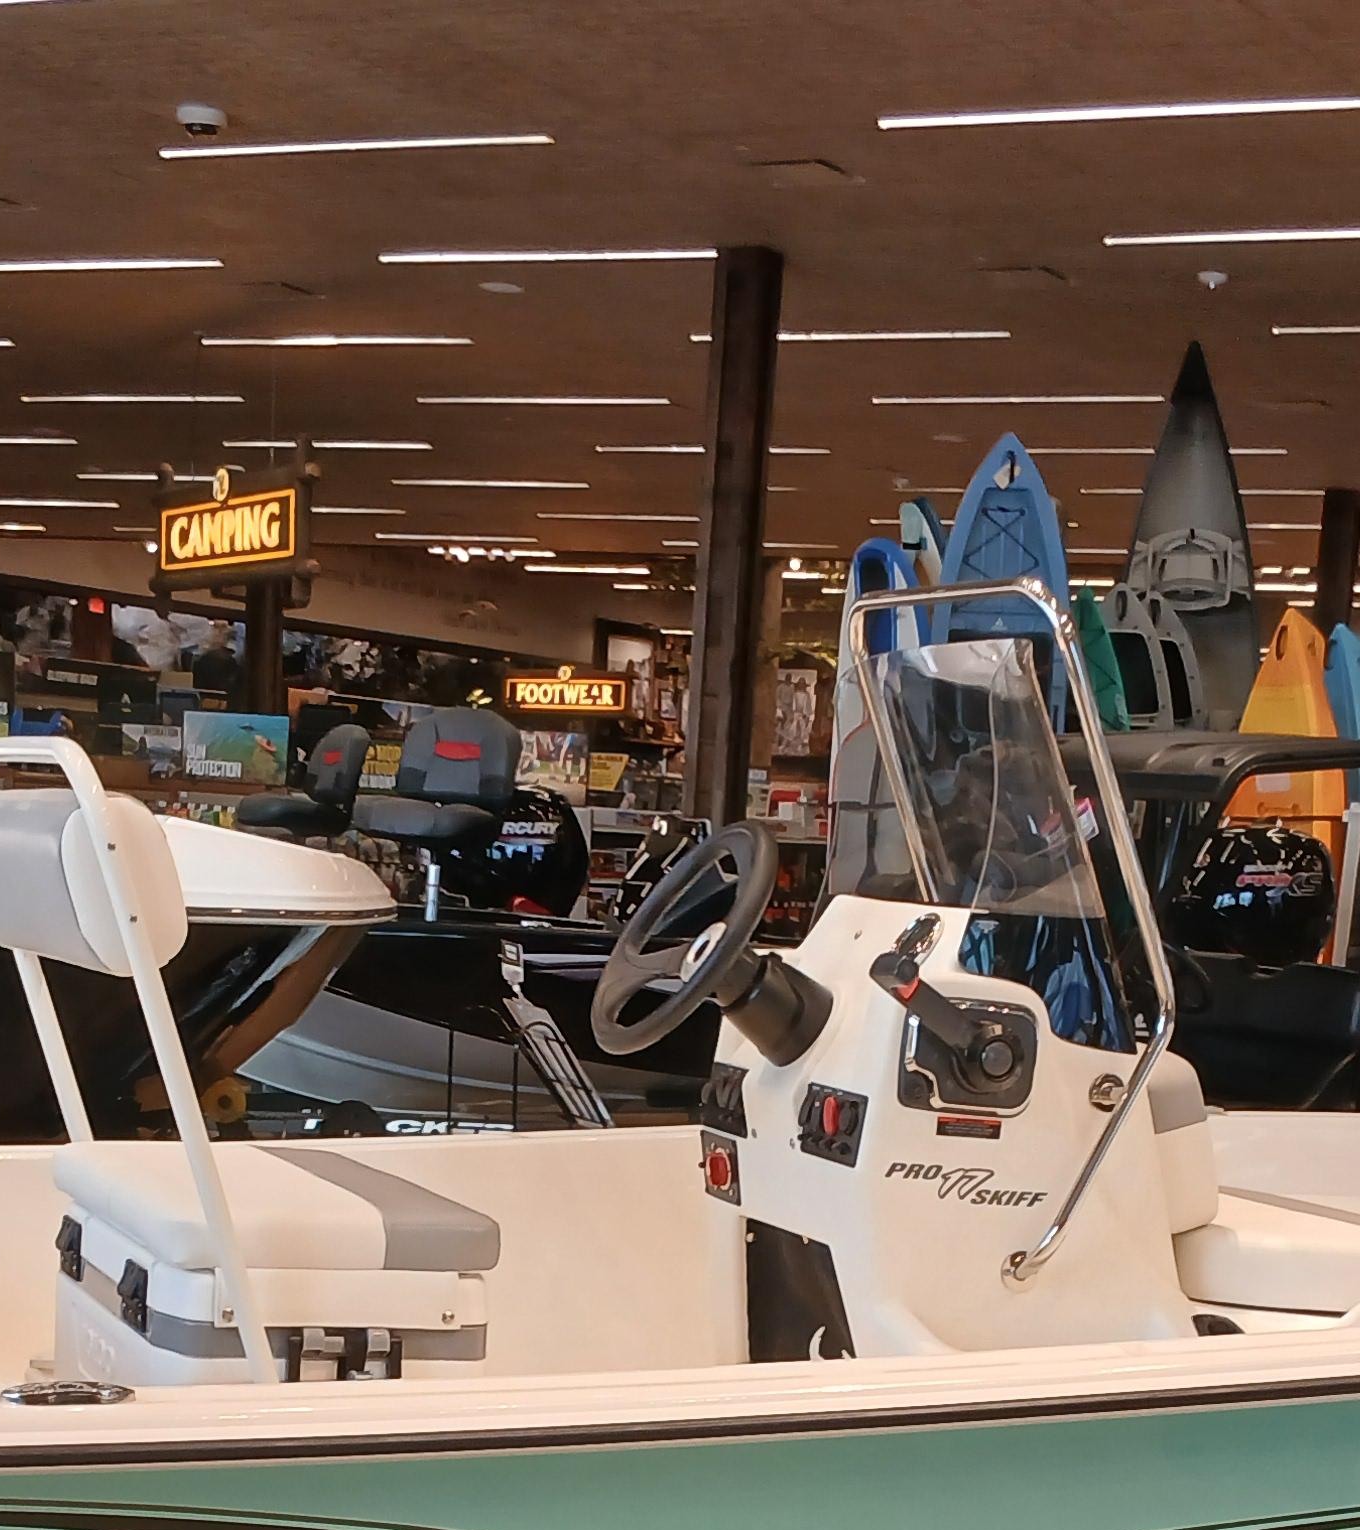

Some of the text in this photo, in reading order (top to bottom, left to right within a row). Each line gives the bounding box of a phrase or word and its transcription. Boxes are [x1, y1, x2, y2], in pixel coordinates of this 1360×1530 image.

[170, 501, 280, 559] CAMPING
[516, 684, 613, 705] FOOTWEAR
[502, 821, 560, 836] RCURY
[885, 1162, 1048, 1207] PRO 17 SKIFF
